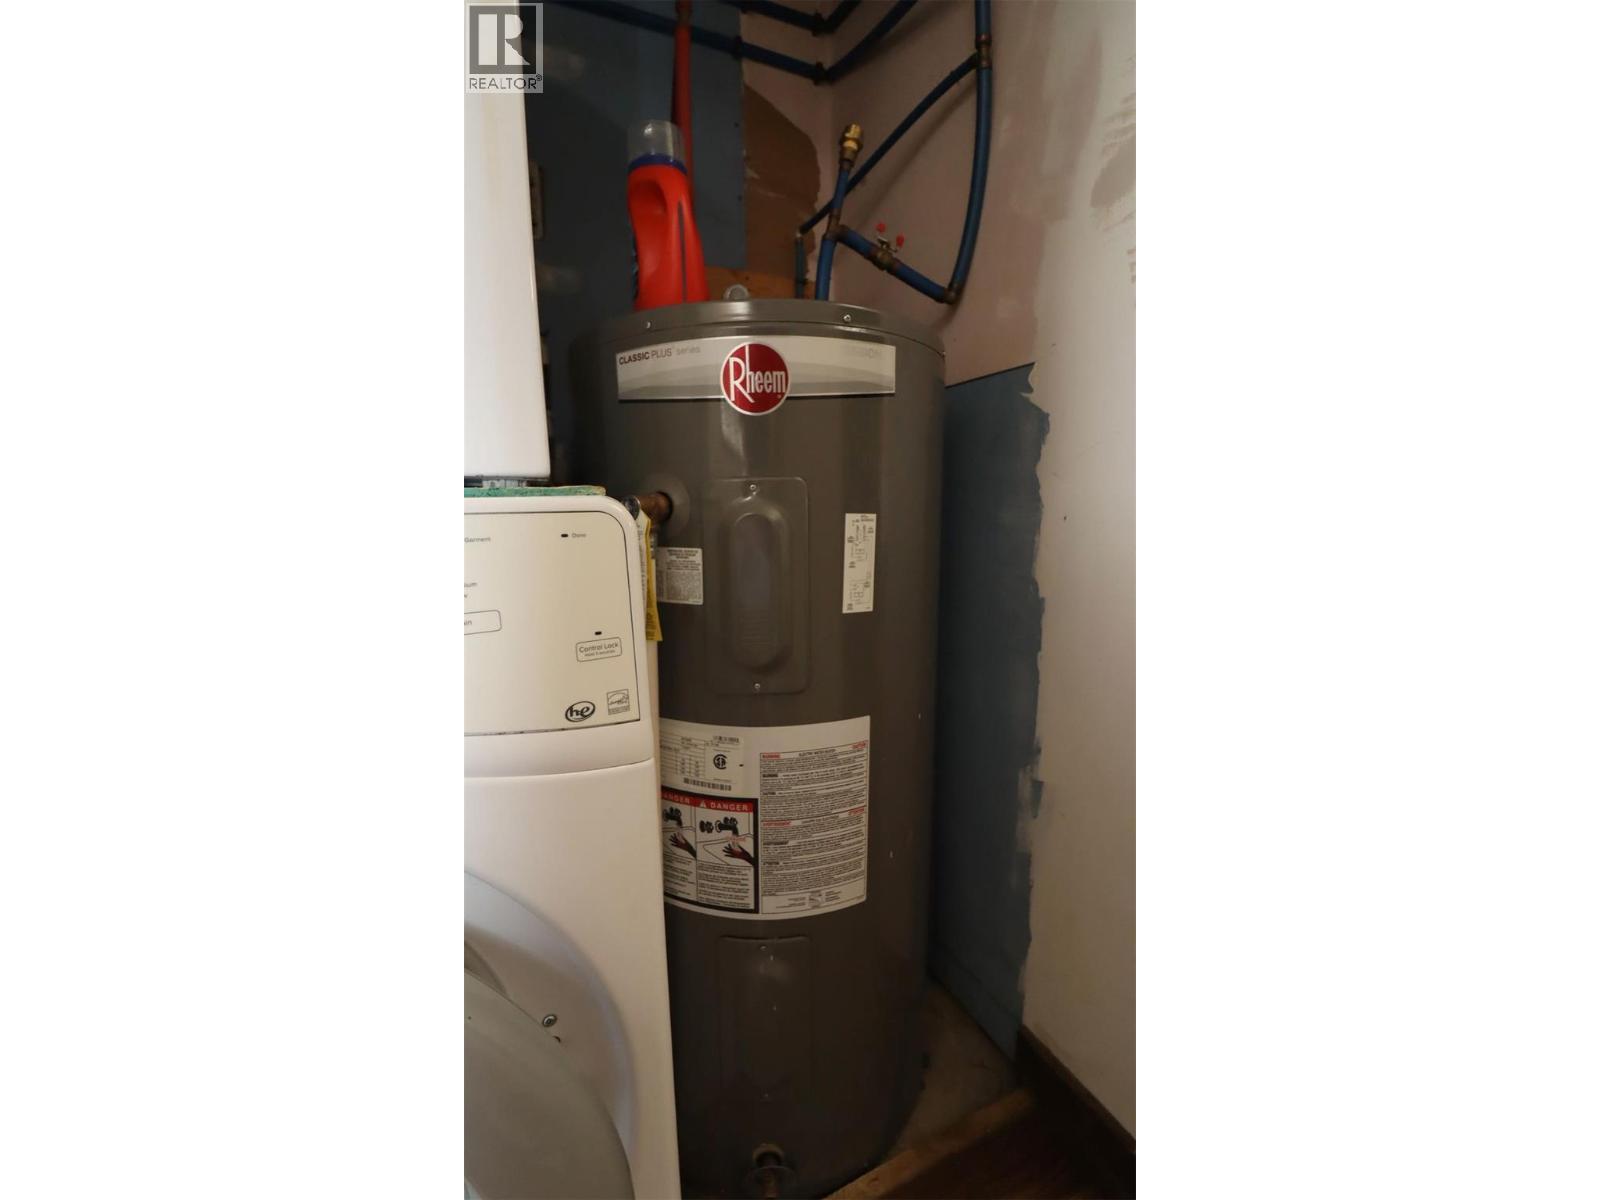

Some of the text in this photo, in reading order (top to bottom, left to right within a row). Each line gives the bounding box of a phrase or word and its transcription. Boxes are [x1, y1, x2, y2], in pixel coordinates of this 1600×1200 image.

[618, 351, 650, 366] CLASSIC
[728, 344, 786, 404] Rheem
[578, 643, 603, 654] Control
[604, 641, 619, 650] Lock
[663, 792, 691, 805] ANGER
[710, 801, 749, 812] DANGER
